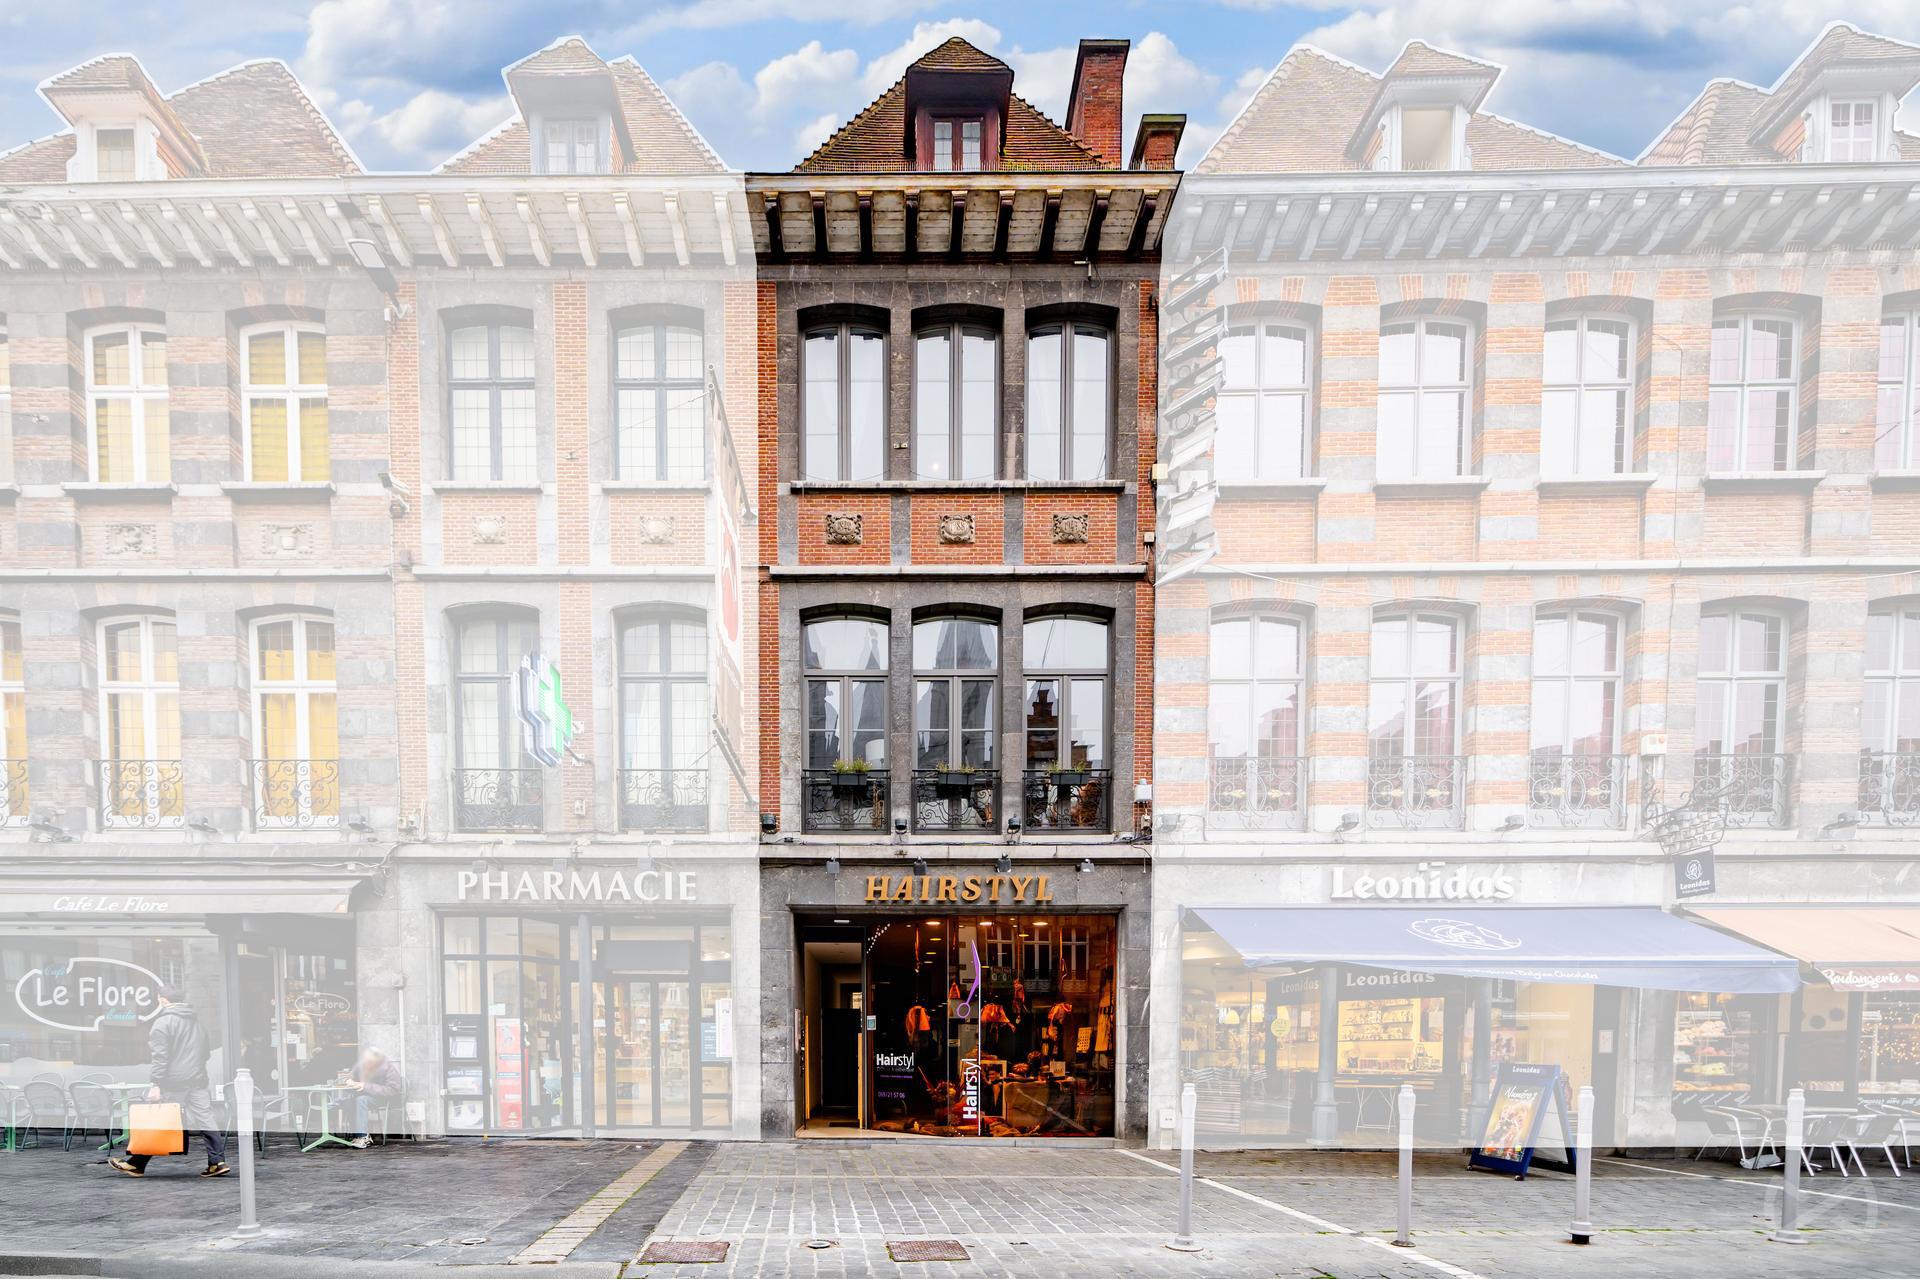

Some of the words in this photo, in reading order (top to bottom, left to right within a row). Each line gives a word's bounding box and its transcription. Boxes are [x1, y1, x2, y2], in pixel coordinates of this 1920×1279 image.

[457, 871, 697, 901] PHARMACIE
[864, 875, 1054, 902] HAIRSTYL
[1330, 864, 1515, 899] Leonidas
[94, 896, 119, 911] Le
[122, 897, 168, 912] Flore
[1281, 977, 1320, 994] Leonidas
[1346, 970, 1435, 987] Leonidas
[36, 977, 70, 1006] Le
[79, 976, 151, 1007] Flore
[876, 1052, 914, 1069] Hairstyl
[1512, 1066, 1540, 1074] Leonidas
[962, 1058, 981, 1119] Hairstyl
